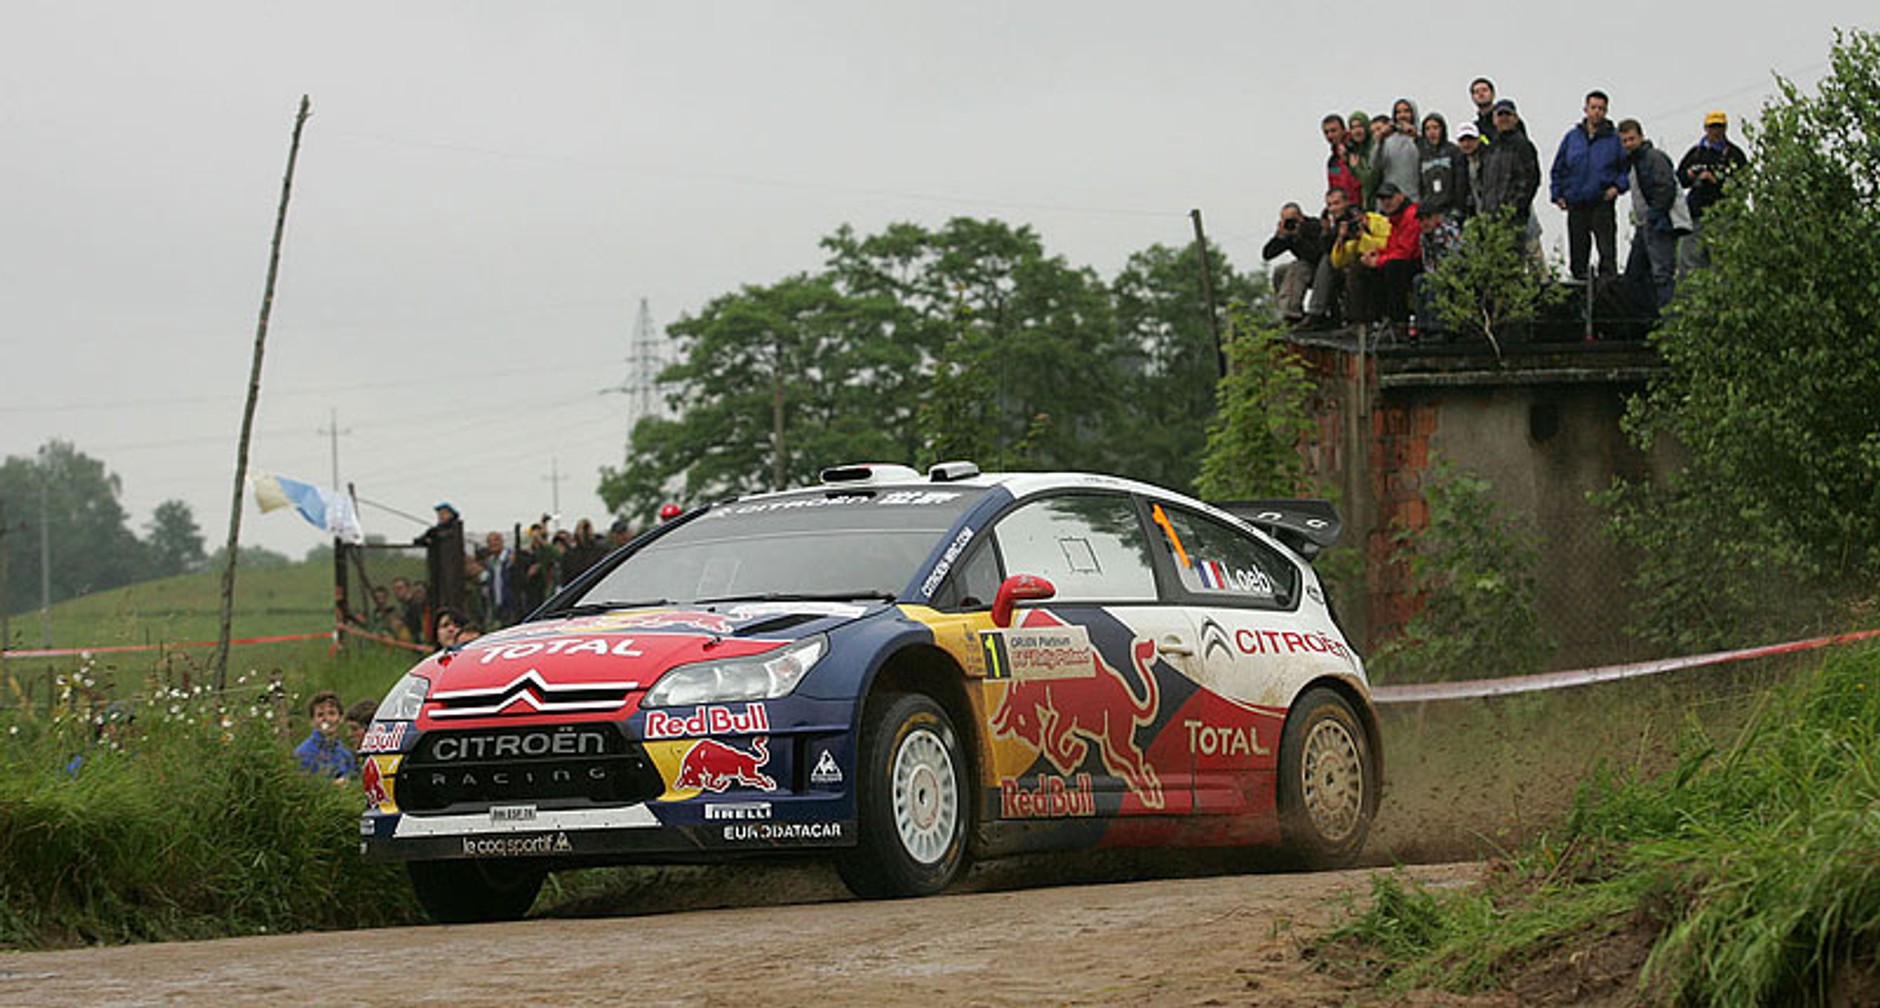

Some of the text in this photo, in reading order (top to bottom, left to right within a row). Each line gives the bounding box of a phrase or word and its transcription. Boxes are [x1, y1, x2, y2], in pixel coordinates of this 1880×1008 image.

[1151, 502, 1191, 569] 1
[1219, 560, 1273, 594] Loeb
[479, 638, 645, 664] TOTAL
[984, 633, 1001, 678] 1
[646, 703, 768, 737] Red Bull
[1184, 719, 1271, 755] TOTAL
[704, 802, 772, 819] PIRELLI
[1001, 772, 1096, 817] Red Bull
[723, 822, 842, 840] EURODATACAR
